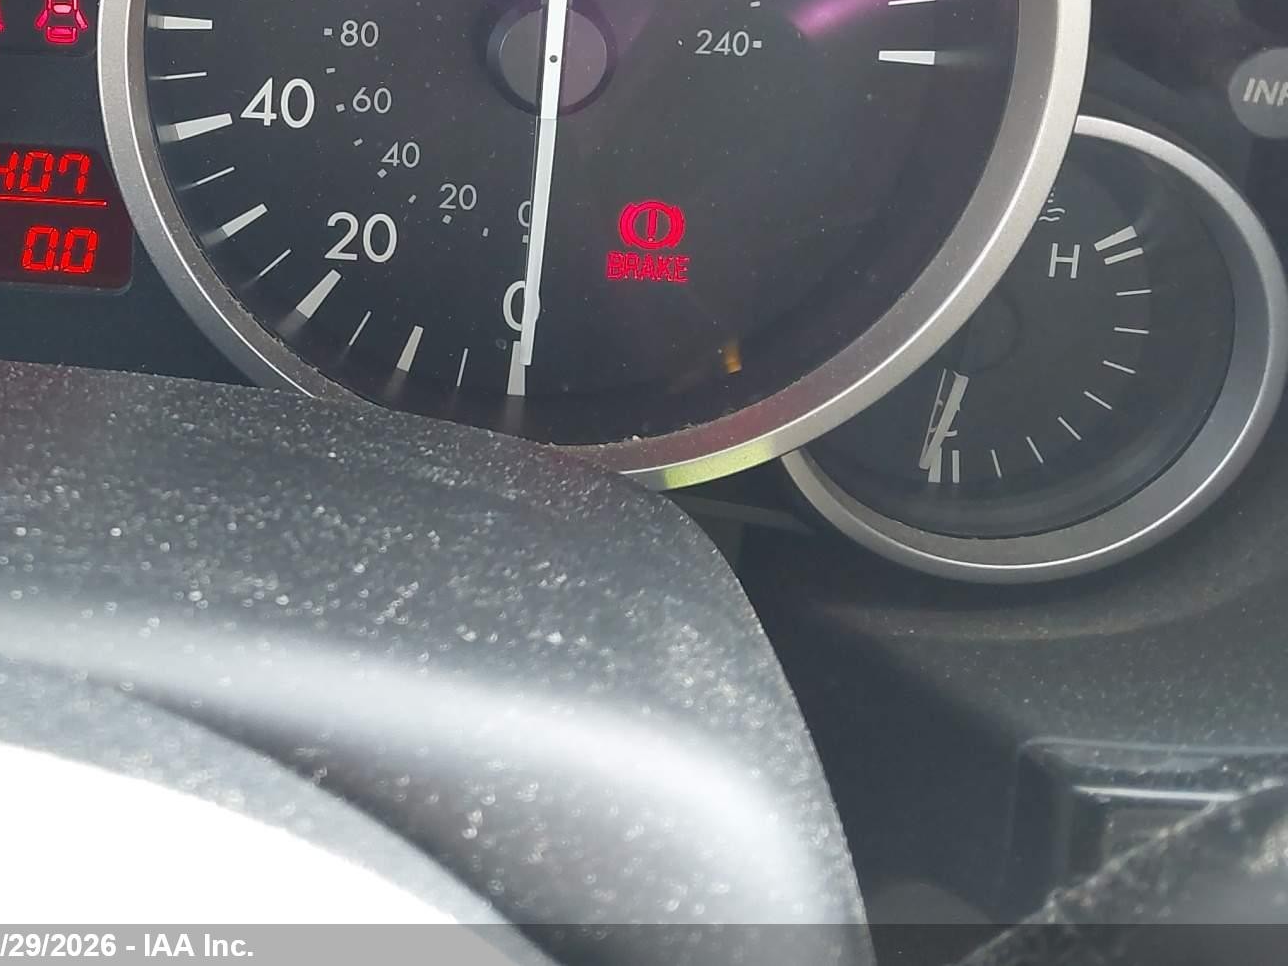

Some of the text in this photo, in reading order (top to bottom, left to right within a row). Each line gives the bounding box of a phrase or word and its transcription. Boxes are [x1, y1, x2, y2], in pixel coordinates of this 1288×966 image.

[339, 19, 380, 48] 80
[694, 29, 750, 57] 240
[240, 77, 315, 129] 40
[351, 86, 393, 115] 60
[380, 141, 421, 168] 40
[438, 183, 478, 211] 20
[21, 225, 99, 274] 0.0
[324, 211, 398, 263] 20
[606, 251, 690, 282] BRAKE
[1048, 242, 1081, 279] H
